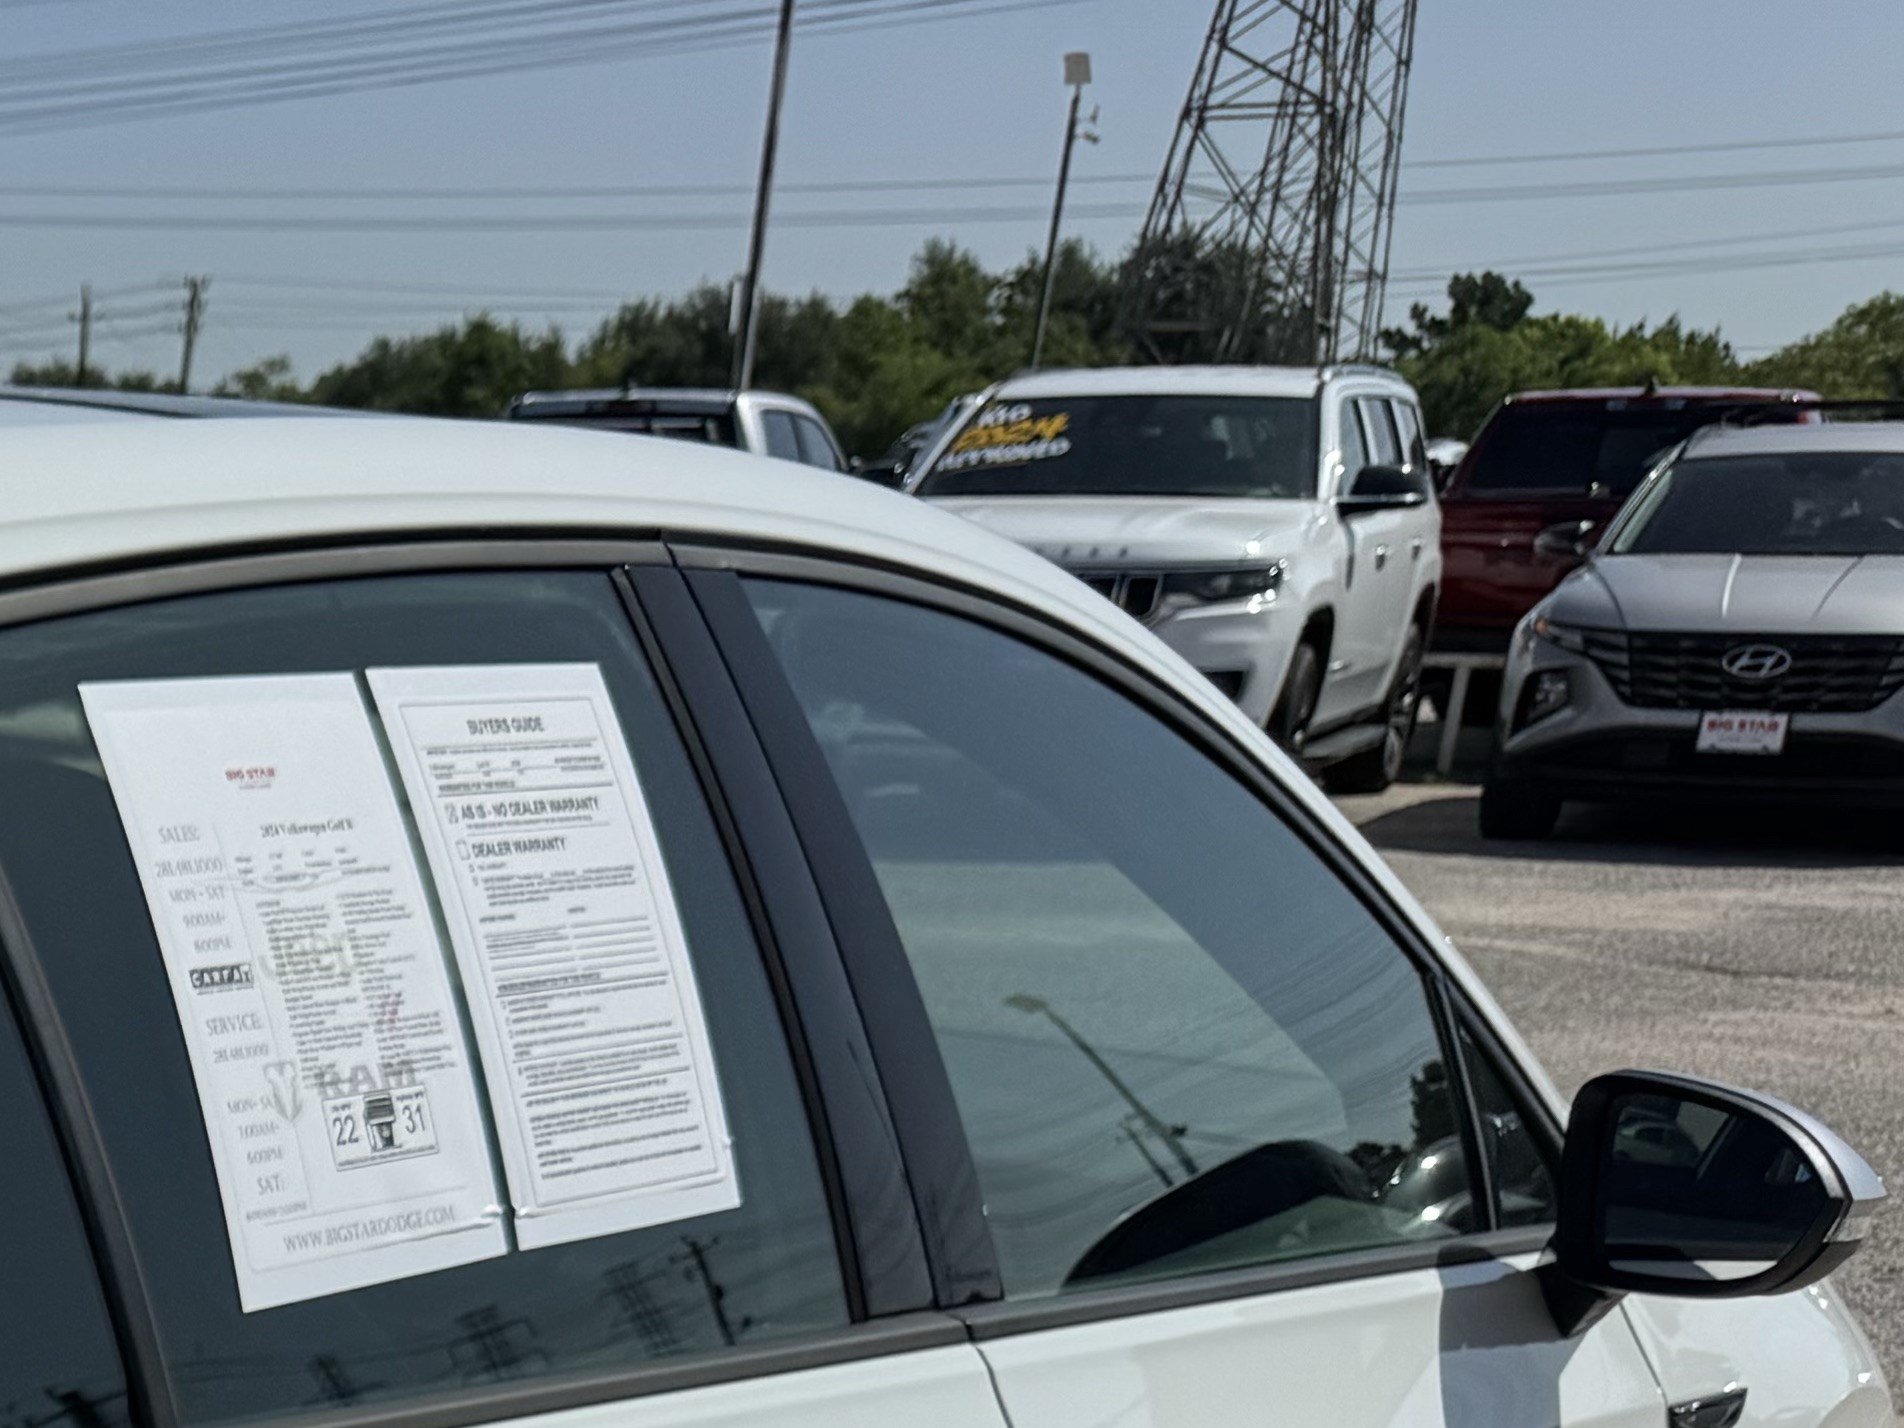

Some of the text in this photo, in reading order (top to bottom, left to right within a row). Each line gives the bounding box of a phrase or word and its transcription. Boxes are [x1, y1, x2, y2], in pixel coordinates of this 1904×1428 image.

[467, 717, 544, 735] BUYERS GUIDE
[461, 803, 476, 820] AS
[493, 801, 508, 818] NO
[509, 798, 547, 817] DEALER
[548, 796, 599, 812] WARRANTY
[472, 837, 566, 858] DEALER WARRANTY
[333, 1104, 426, 1147] 22 31
[283, 1205, 456, 1252] WWW.BIGSTARDODGE.COM
